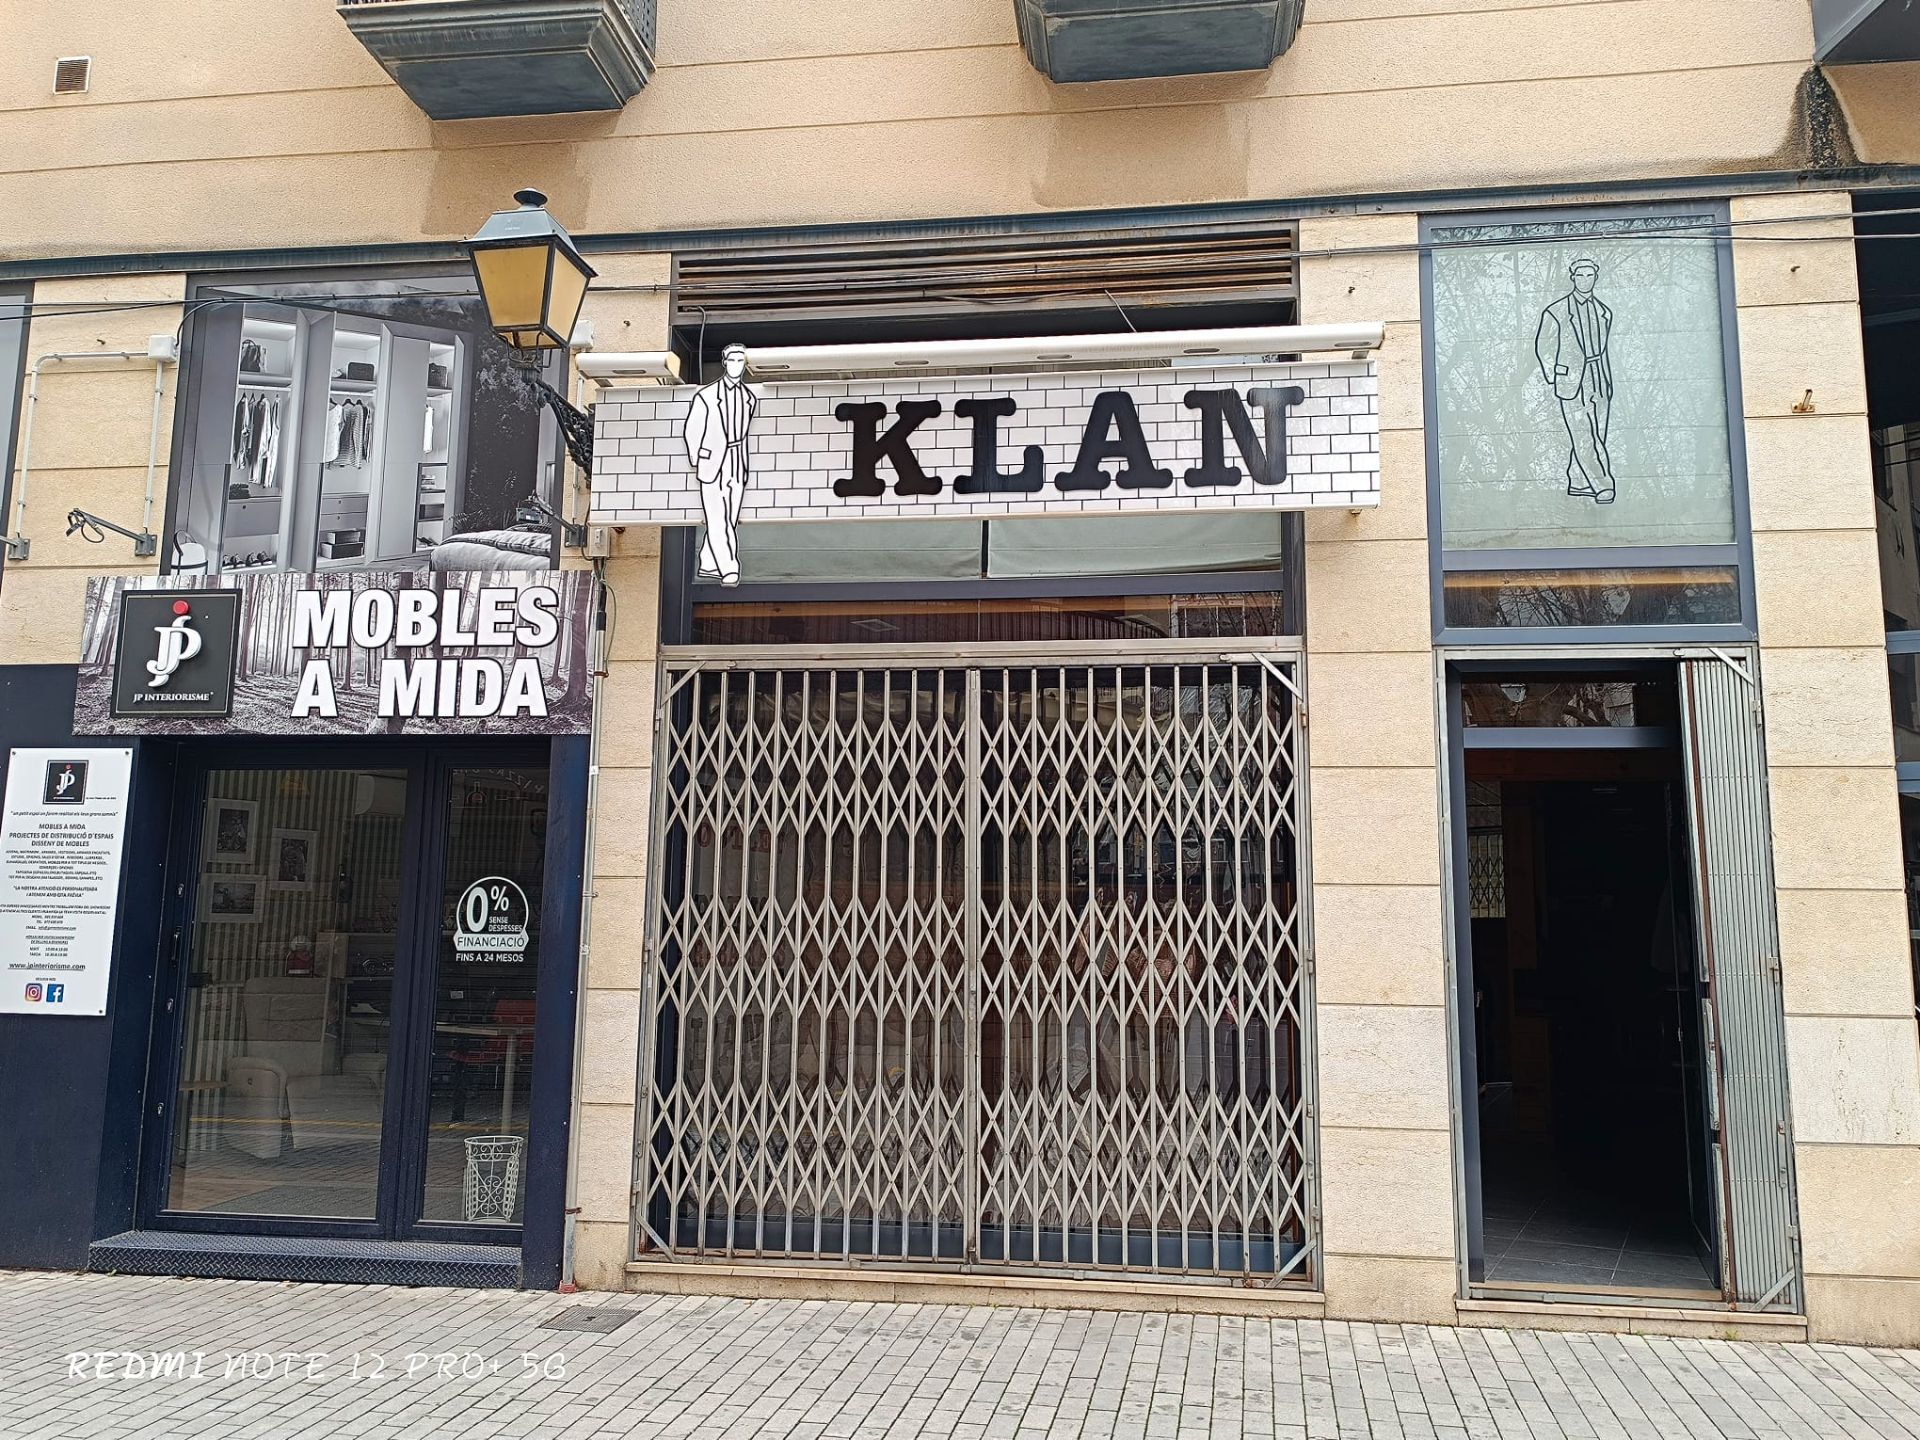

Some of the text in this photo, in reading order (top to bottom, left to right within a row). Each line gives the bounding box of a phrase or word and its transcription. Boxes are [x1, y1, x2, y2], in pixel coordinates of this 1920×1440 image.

[832, 386, 1305, 498] KLAN
[292, 586, 560, 648] MOBLES
[133, 693, 144, 703] JP
[290, 657, 549, 718] A MIDA
[456, 953, 524, 962] FINS A 24 MESOS
[457, 935, 525, 947] FINANCIACIÓ
